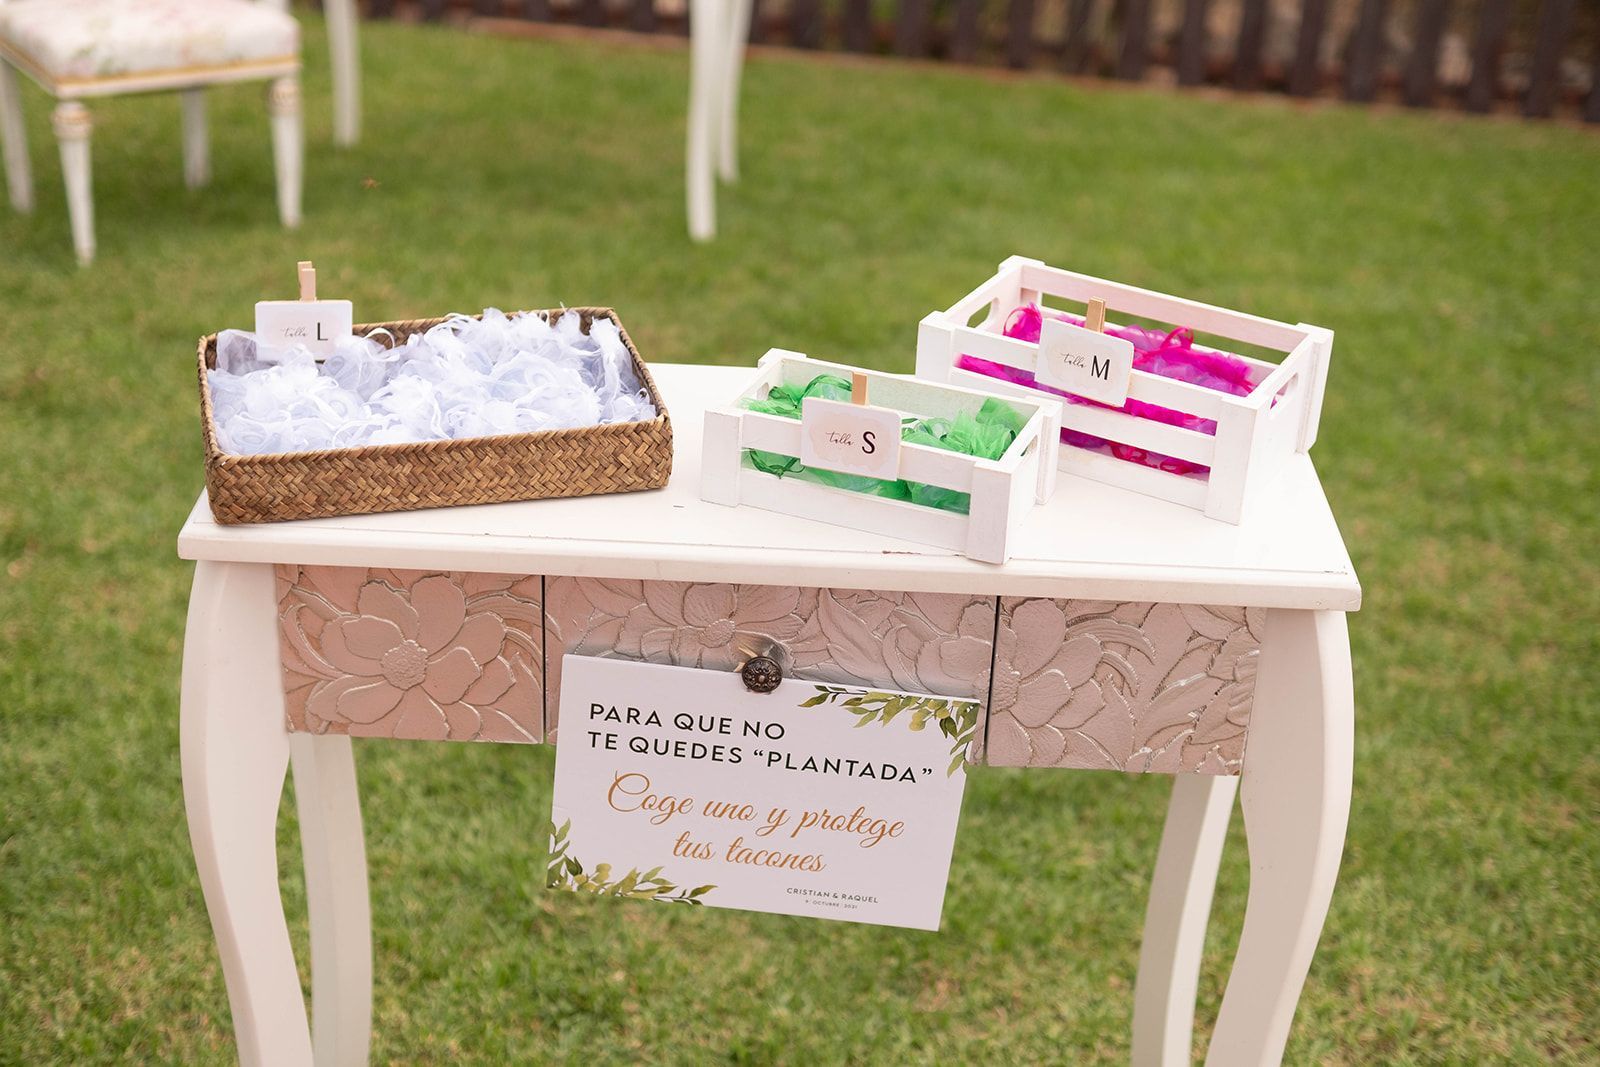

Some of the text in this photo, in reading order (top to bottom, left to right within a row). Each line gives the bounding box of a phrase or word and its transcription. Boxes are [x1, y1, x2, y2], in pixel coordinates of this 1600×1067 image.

[316, 322, 328, 341] L
[1090, 354, 1111, 380] M
[861, 430, 876, 454] S
[589, 703, 786, 740] PARA QUE NO
[587, 731, 933, 783] TE QUEDES “PLANTADA”
[607, 770, 905, 848] Coge uno y protege
[672, 830, 827, 872] tus tacones
[786, 887, 830, 898] CRISTIAN
[841, 893, 879, 904] RAQUEL
